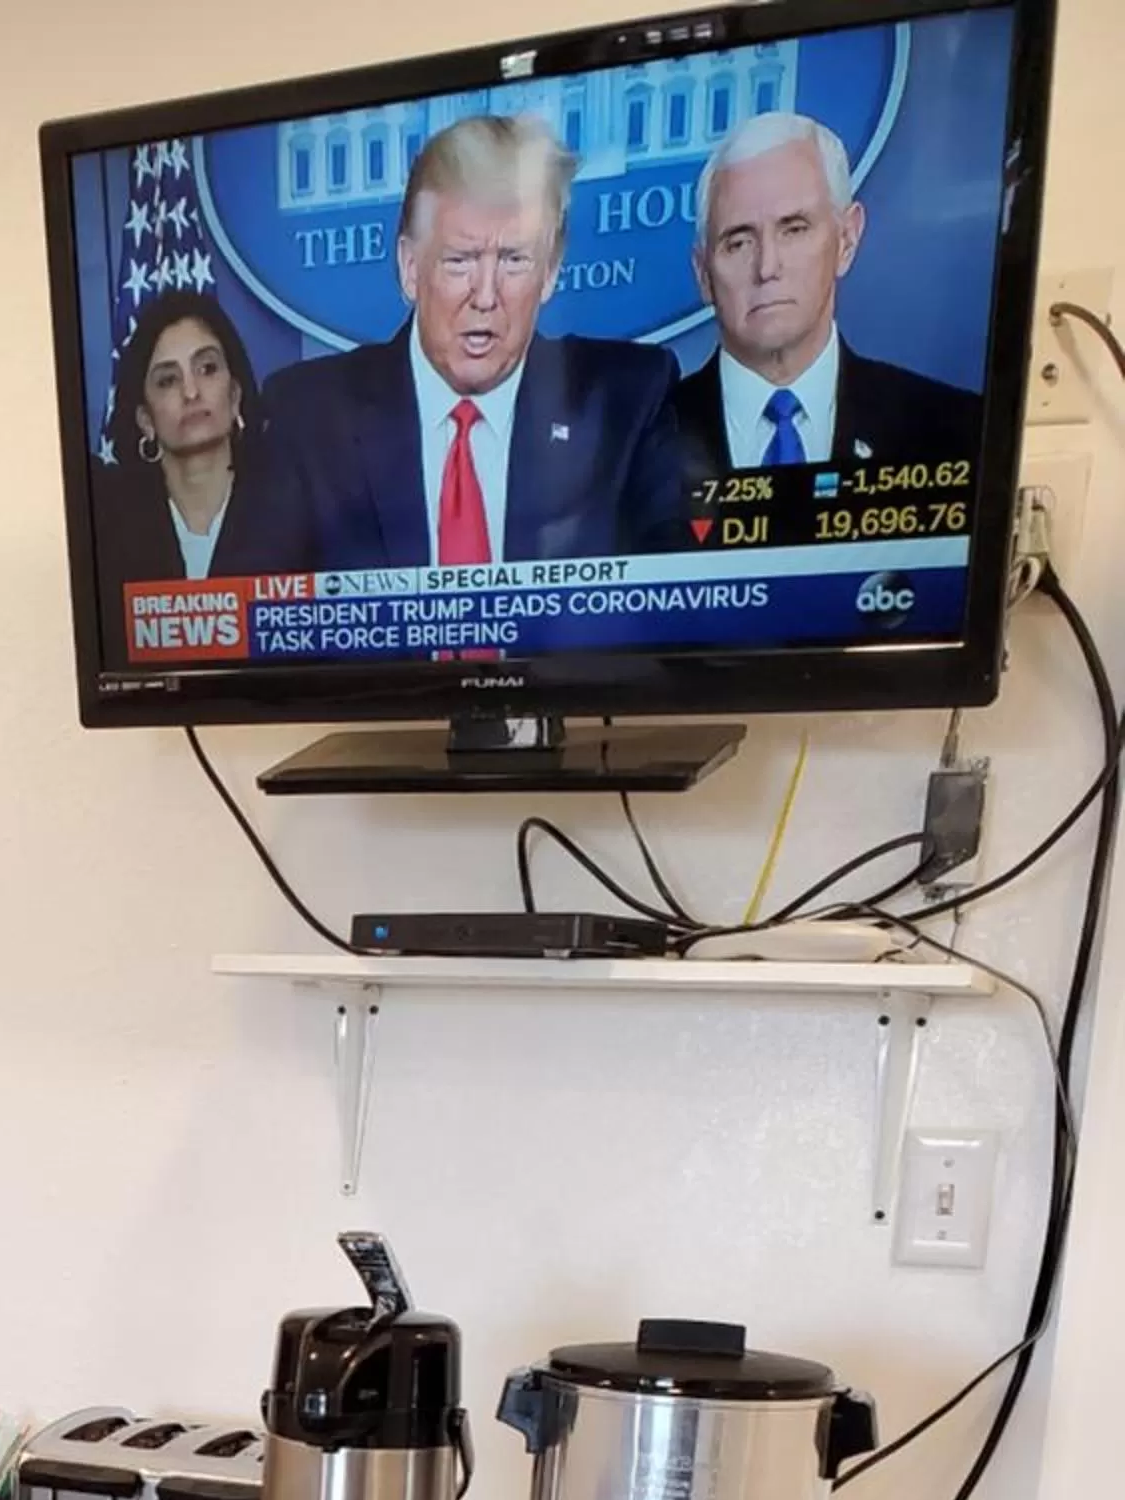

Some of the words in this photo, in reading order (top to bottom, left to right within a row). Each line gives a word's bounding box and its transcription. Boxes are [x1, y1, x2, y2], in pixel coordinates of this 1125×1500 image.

[295, 222, 387, 268] THE
[692, 476, 773, 502] -7.25%
[842, 460, 970, 494] -1,540.62
[722, 516, 768, 544] DJI
[814, 502, 966, 539] 19,696.76
[254, 576, 307, 600] LIVE
[343, 572, 410, 593] NEWS
[426, 568, 522, 590] SPECIAL
[531, 561, 629, 584] REPORT
[132, 592, 238, 616] BREAKING
[255, 601, 381, 627] PRESIDENT
[388, 597, 474, 622] TRUMP
[480, 593, 562, 619] LEADS
[568, 583, 769, 615] CORONAVIRUS
[855, 584, 915, 612] abc
[134, 614, 240, 648] NEWS
[256, 630, 314, 653] TASK
[320, 626, 400, 650] FORCE
[406, 621, 519, 648] BRIEFING
[460, 676, 525, 689] FUNAI
